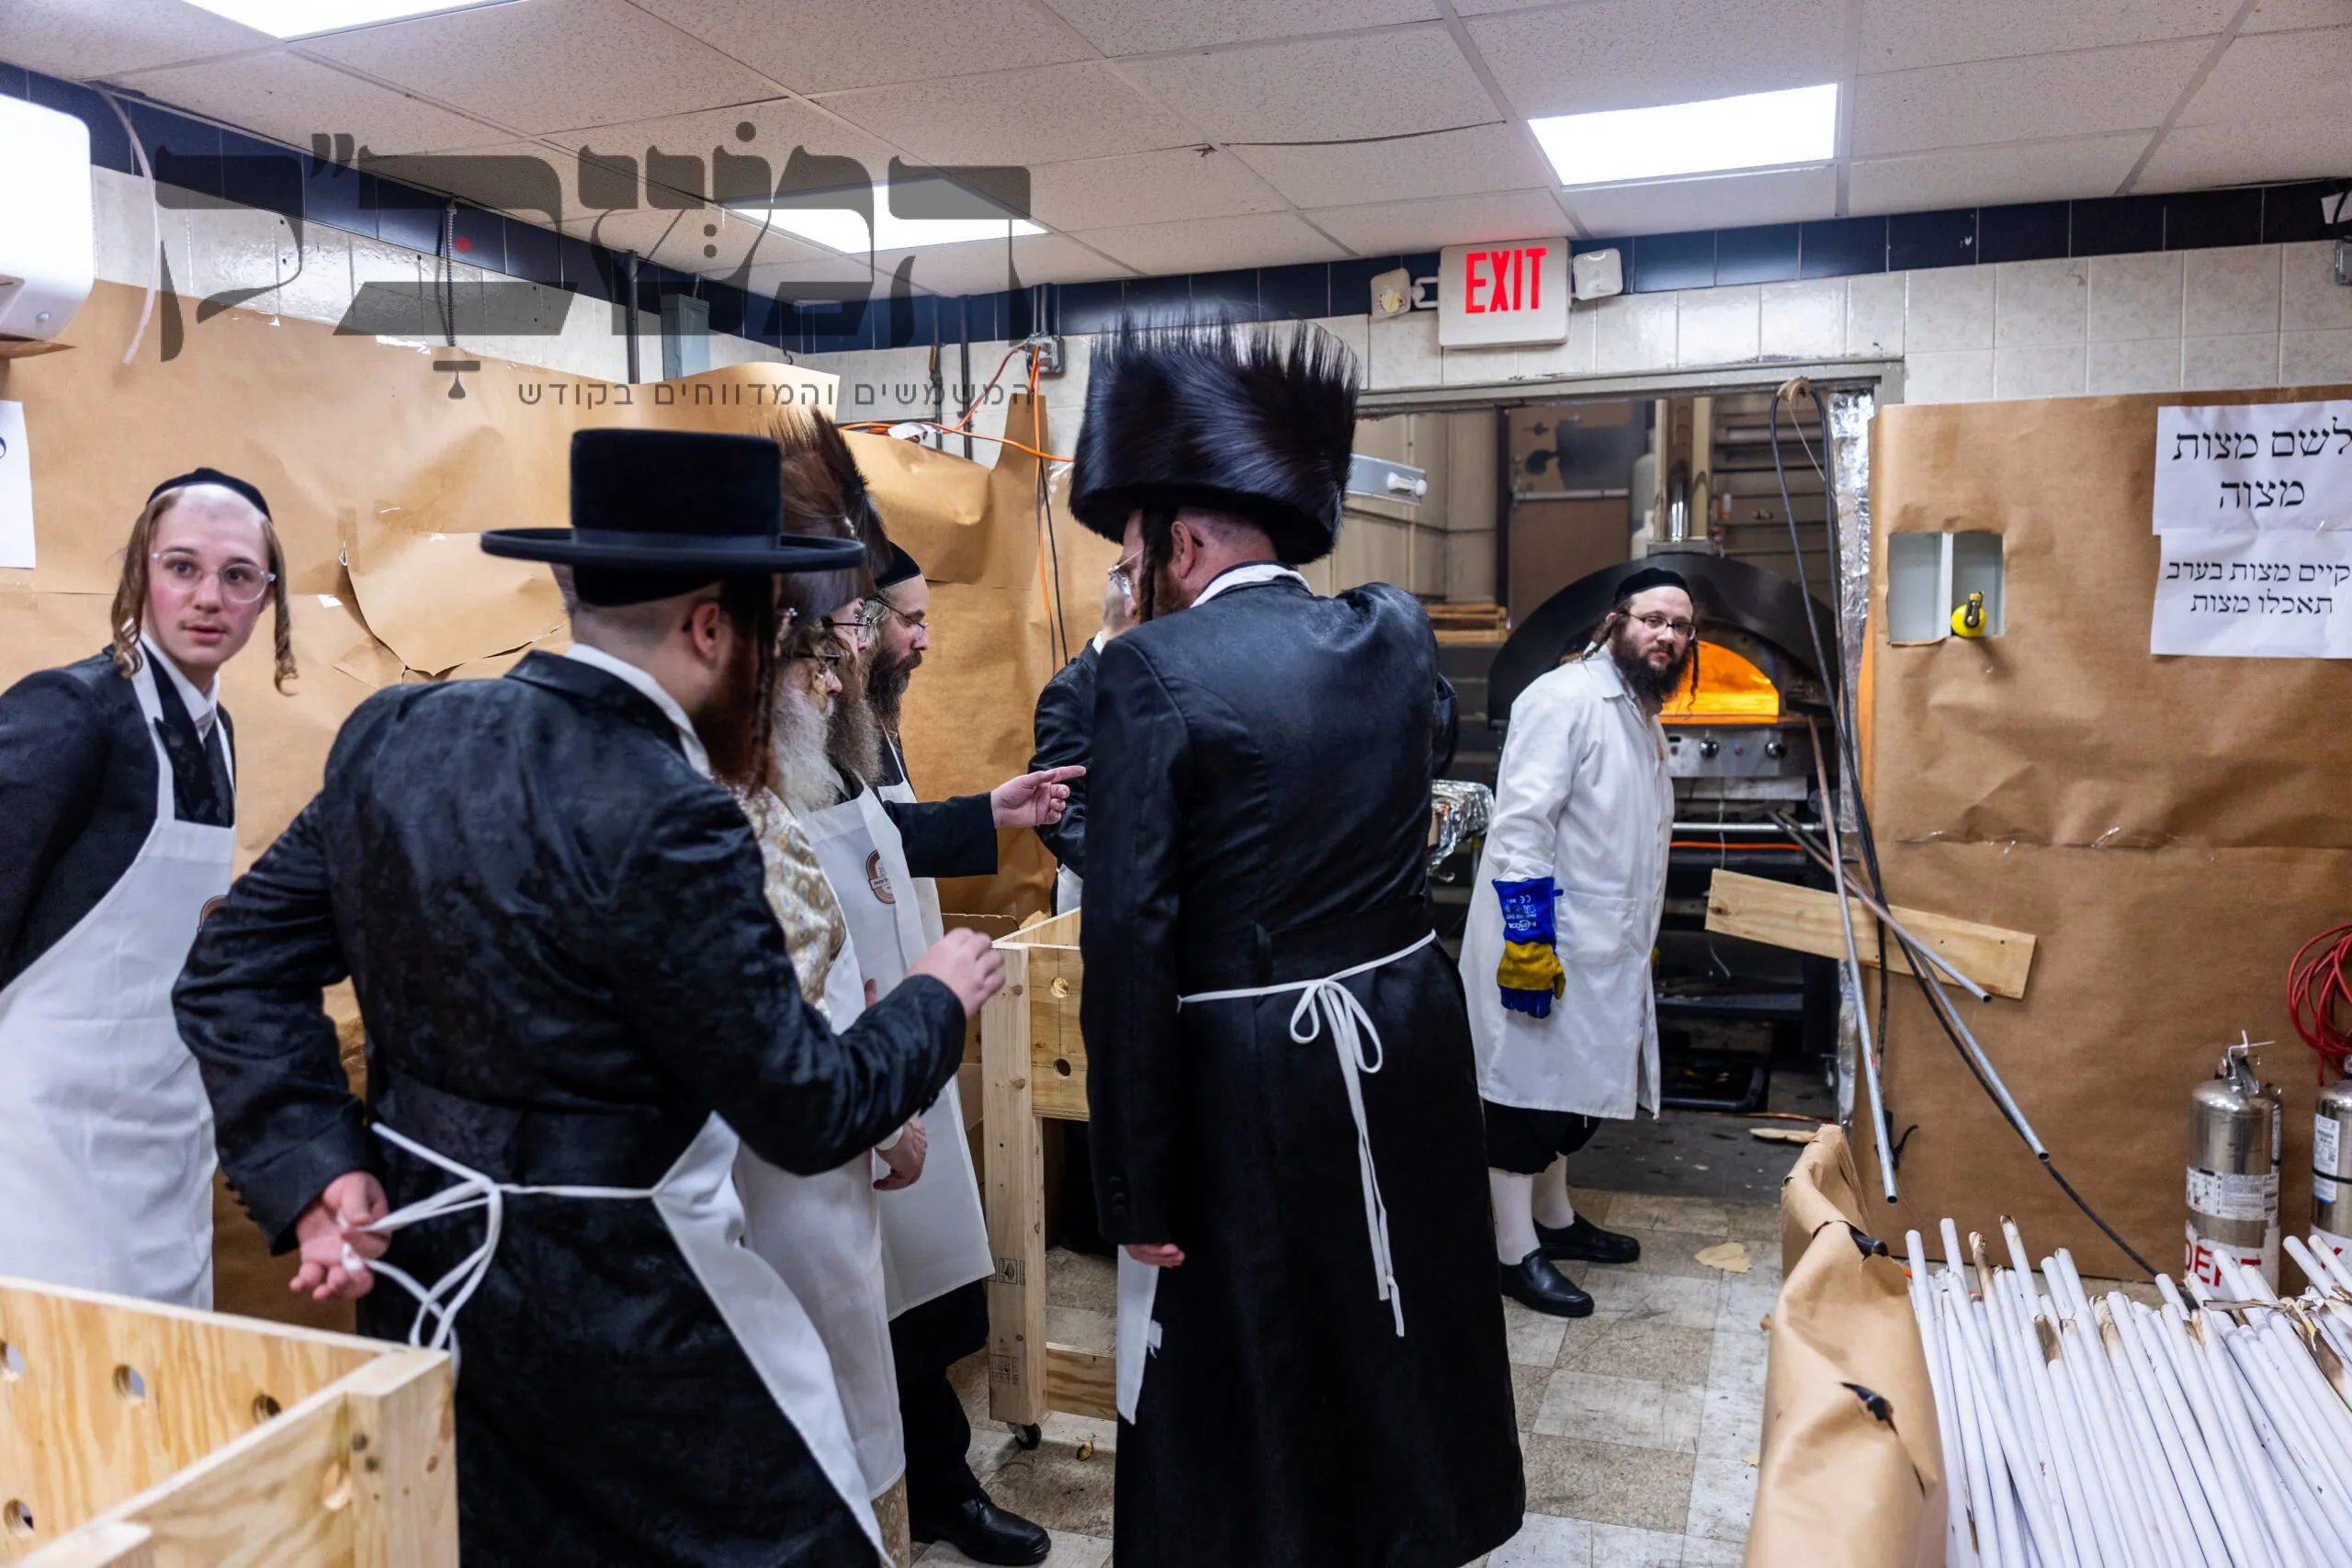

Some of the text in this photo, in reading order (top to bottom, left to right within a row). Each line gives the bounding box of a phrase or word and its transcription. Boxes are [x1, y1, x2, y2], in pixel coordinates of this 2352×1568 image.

[1464, 247, 1547, 314] EXIT
[2172, 415, 2352, 461] לשם מצות
[2219, 479, 2305, 509] מצוה
[2165, 560, 2223, 581] בערב
[2230, 562, 2291, 582] מצות
[2190, 588, 2334, 615] תאכלו מצות
